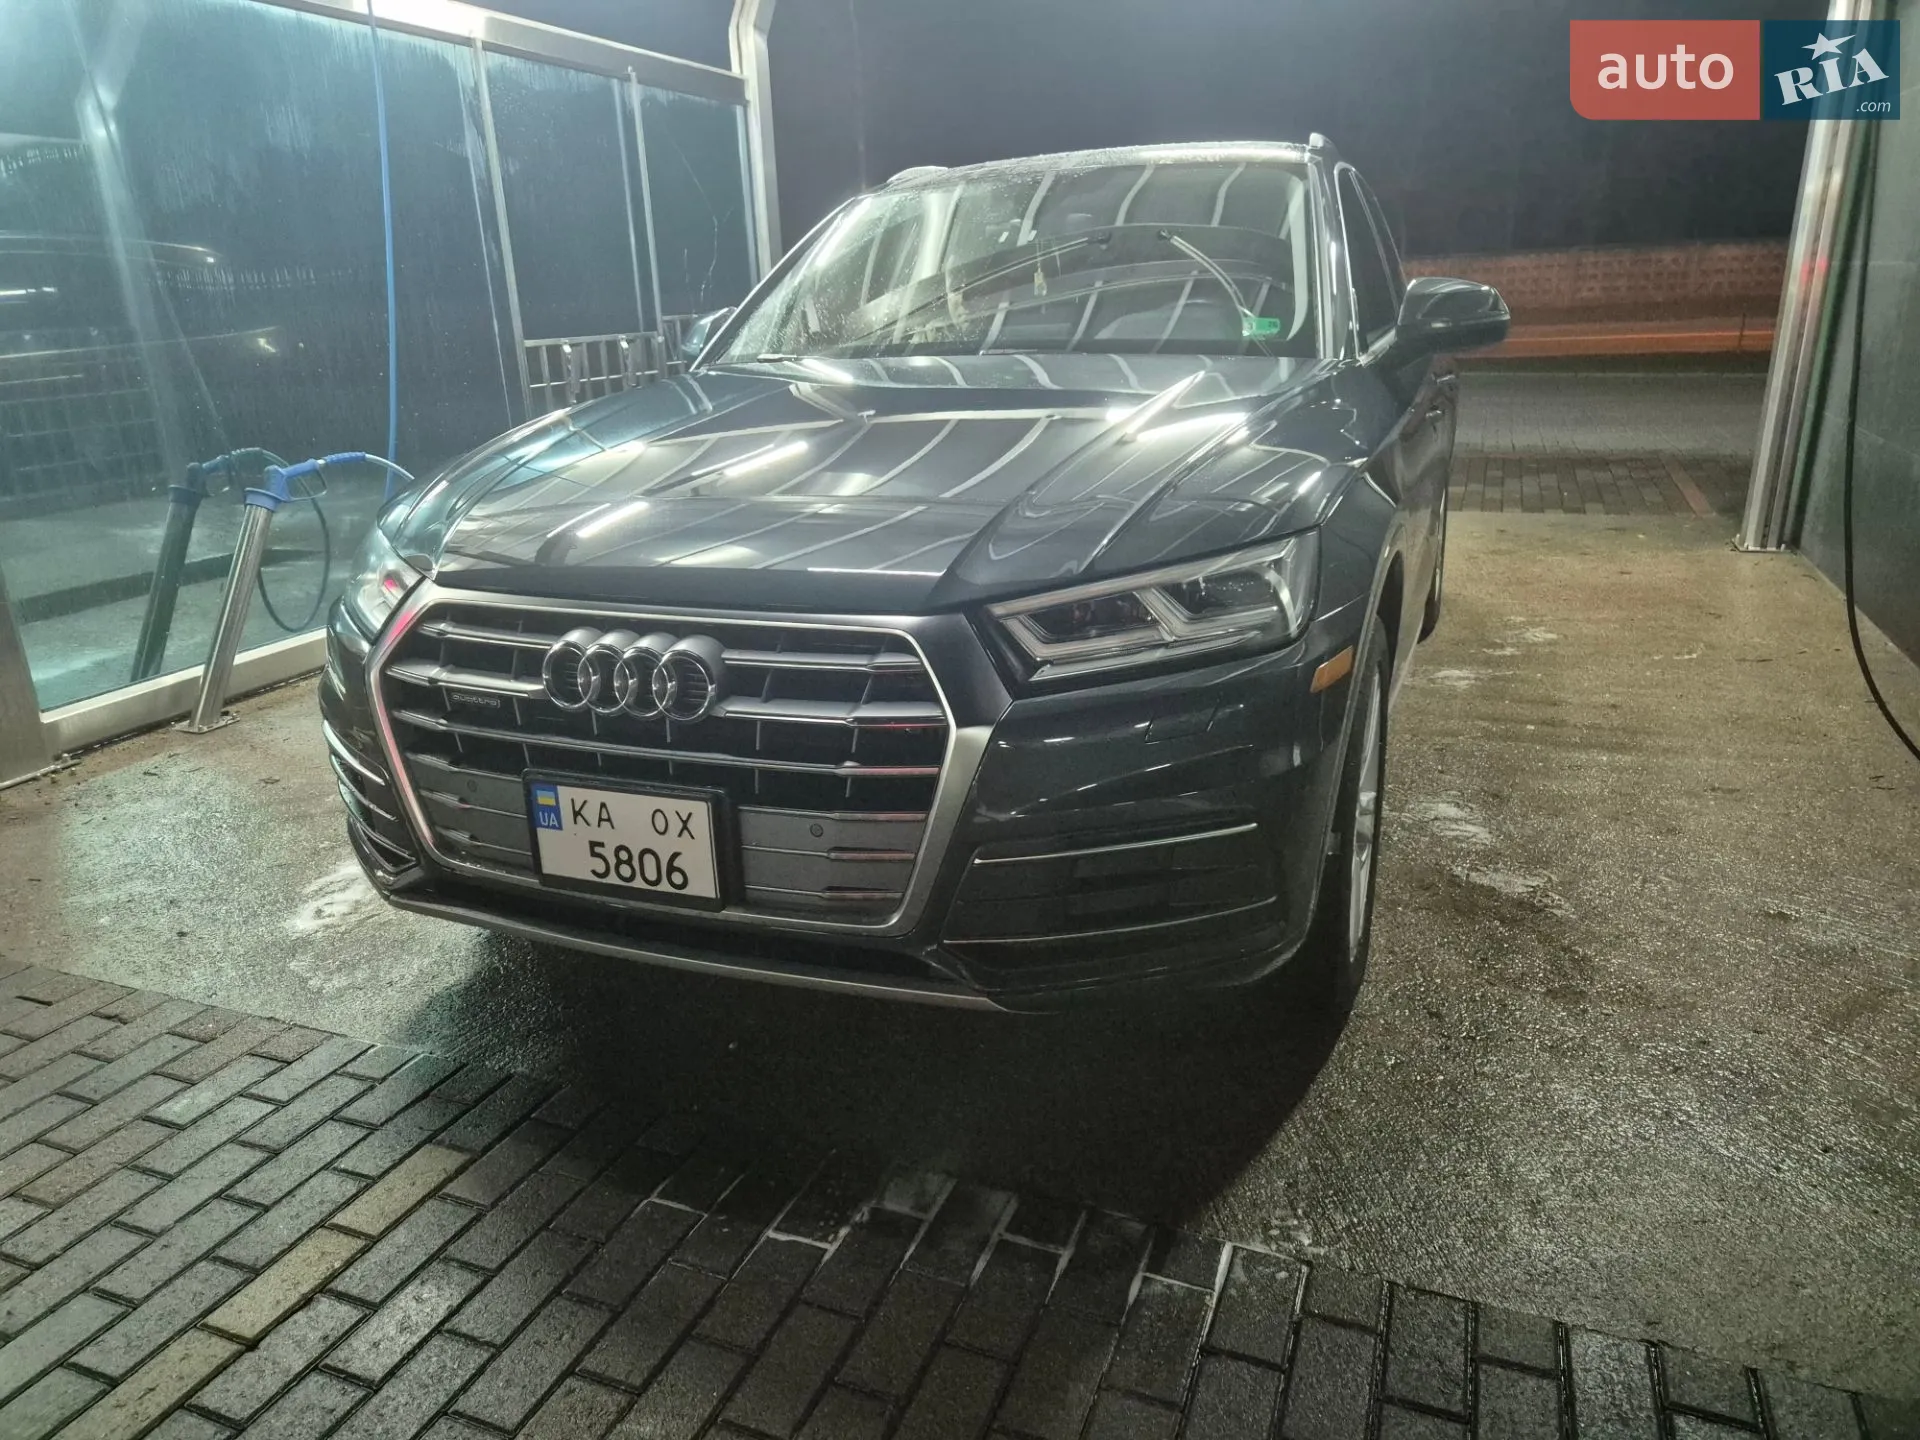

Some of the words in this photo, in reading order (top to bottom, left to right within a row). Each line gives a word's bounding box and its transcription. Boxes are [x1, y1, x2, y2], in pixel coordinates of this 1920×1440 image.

[539, 811, 559, 828] UA
[570, 798, 615, 830] KA
[651, 808, 695, 840] OX
[589, 840, 689, 891] 5806
